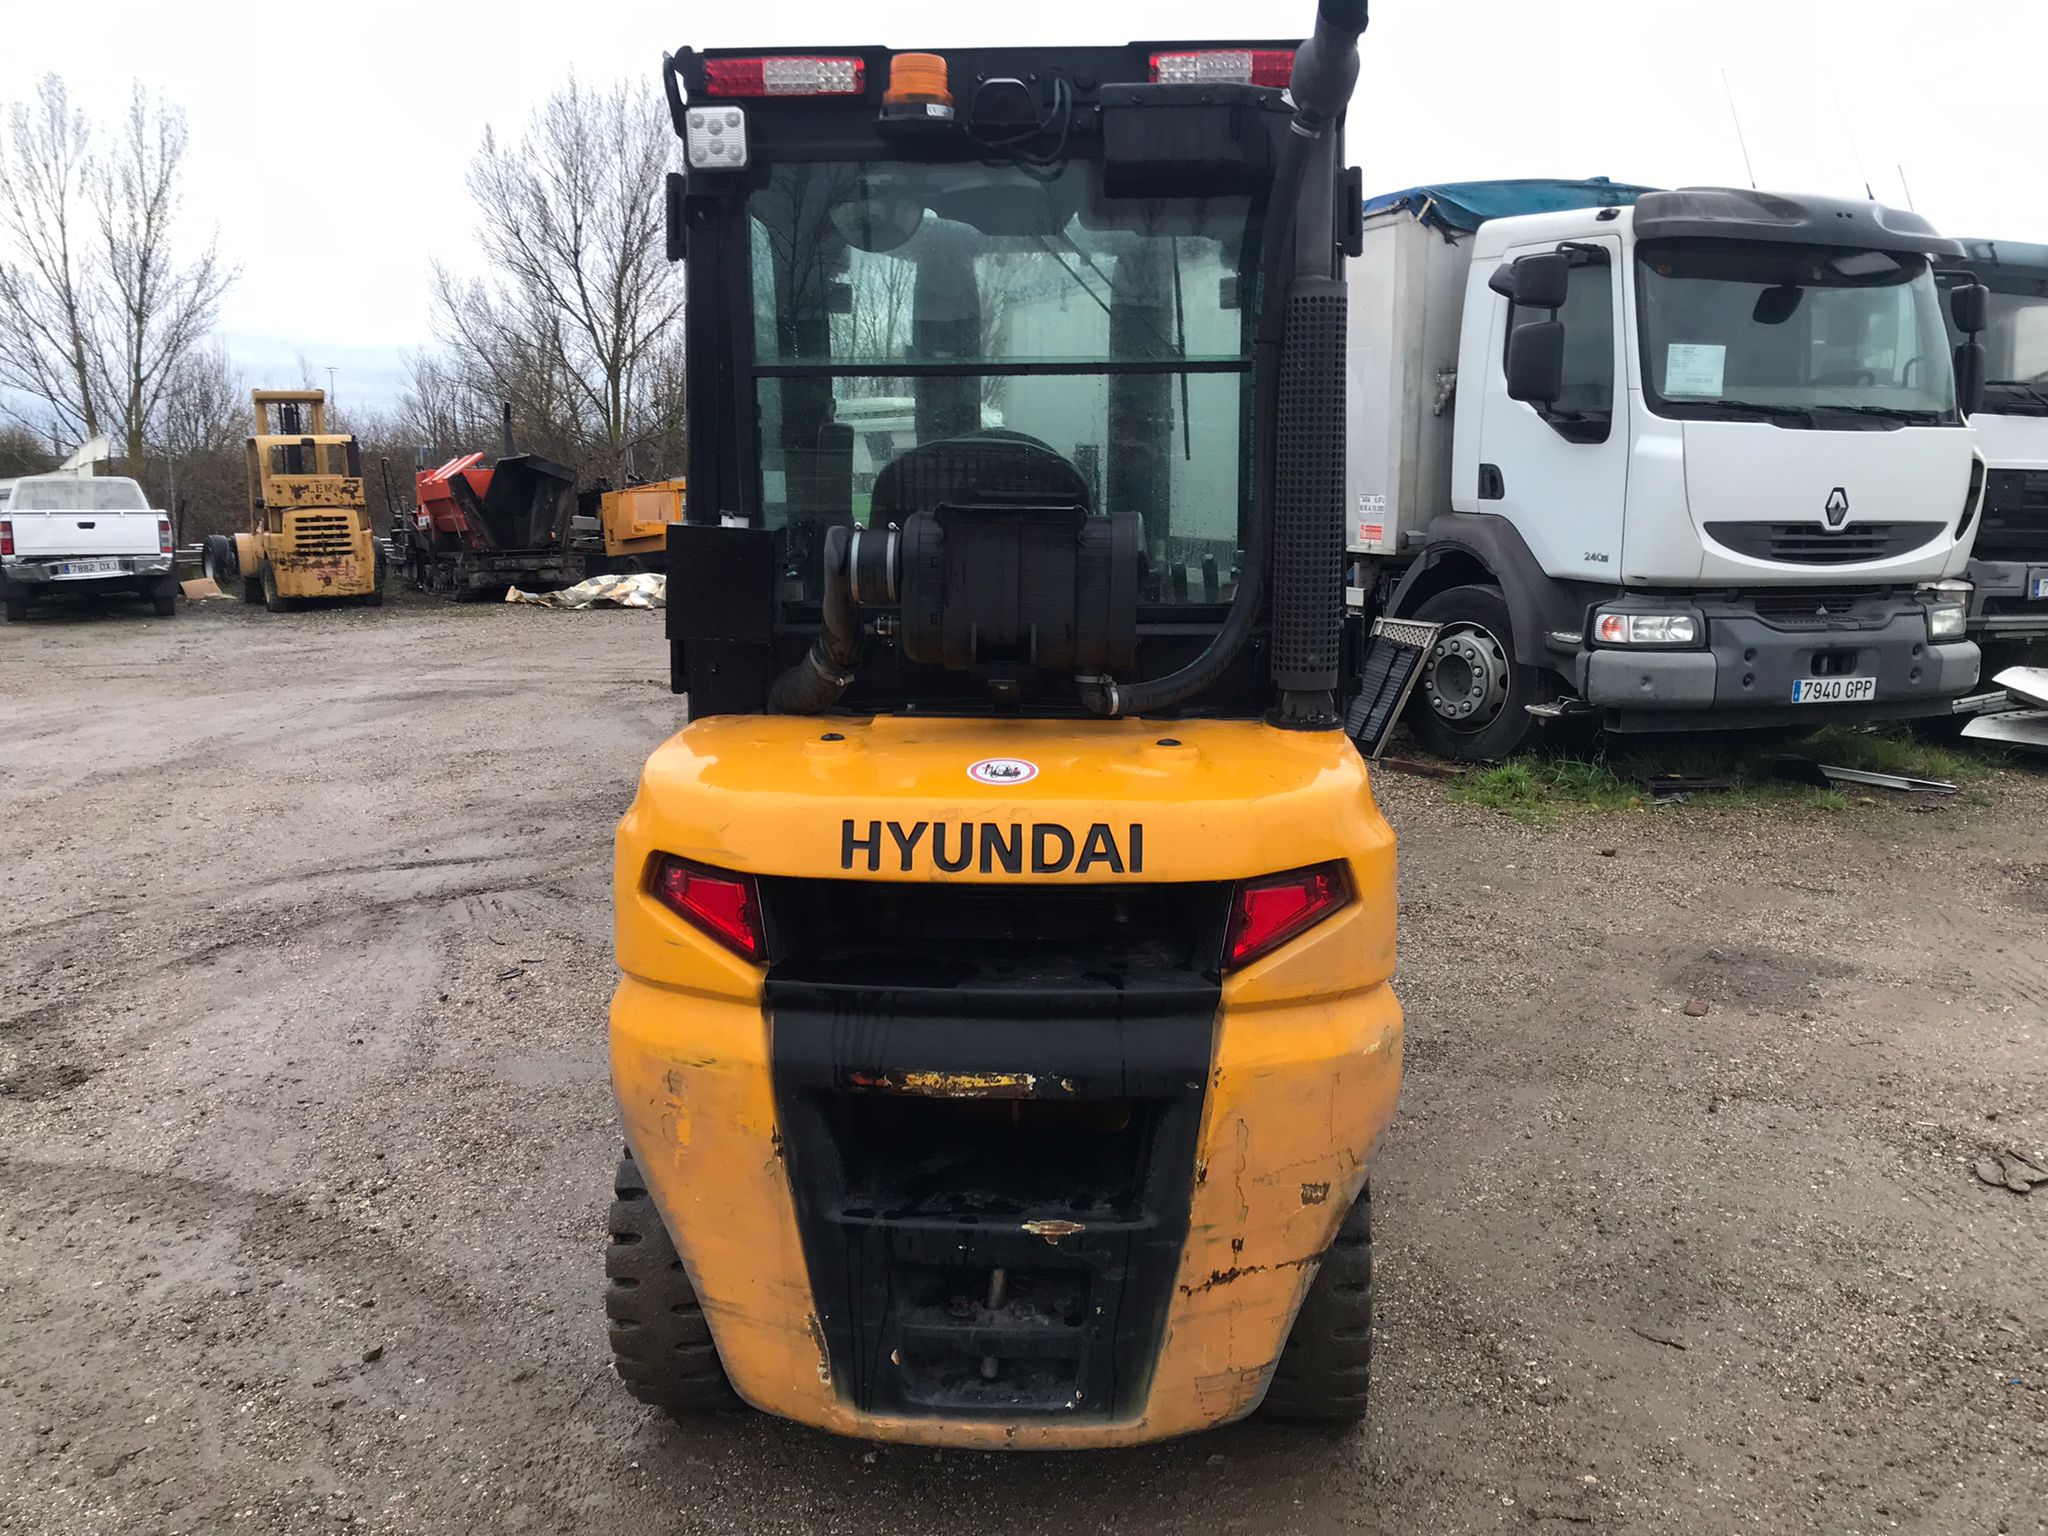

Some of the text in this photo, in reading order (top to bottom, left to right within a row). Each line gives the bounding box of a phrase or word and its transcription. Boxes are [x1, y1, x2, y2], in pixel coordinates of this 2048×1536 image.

[71, 564, 95, 573] 7882
[1803, 680, 1872, 700] 7940 GPP
[841, 819, 1143, 873] HYUNDAI
